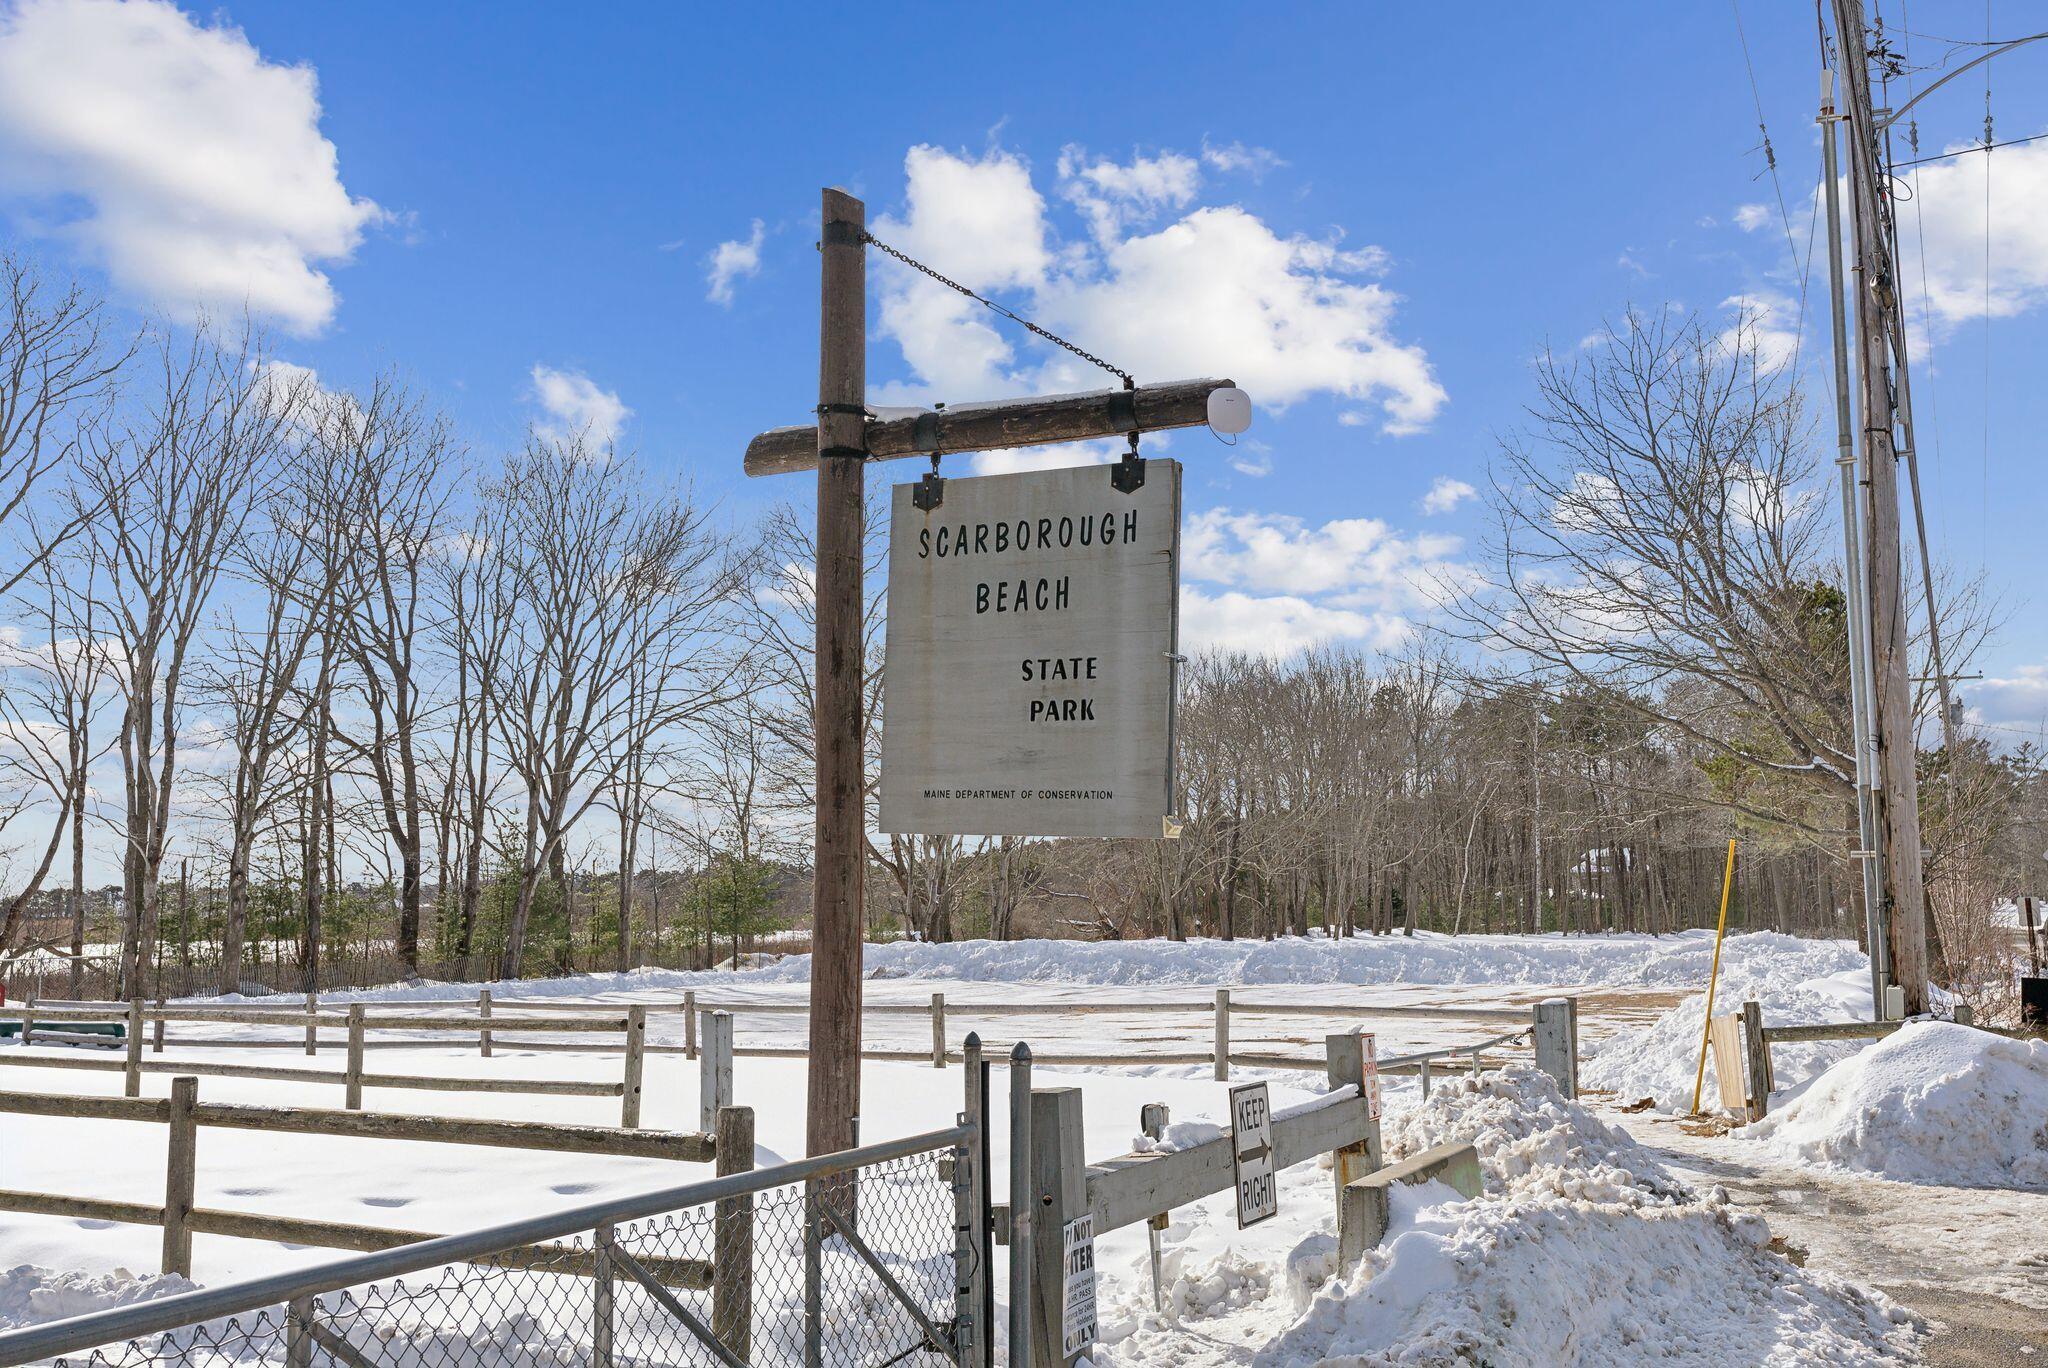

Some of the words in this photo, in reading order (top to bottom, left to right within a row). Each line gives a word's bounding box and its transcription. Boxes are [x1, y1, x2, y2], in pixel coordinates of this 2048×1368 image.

[918, 509, 1137, 558] SCARBOROUGH
[976, 576, 1069, 614] BEACH
[1021, 657, 1097, 681] STATE
[1030, 699, 1095, 722] PARK
[923, 789, 951, 799] MAINE
[955, 789, 1016, 799] DEPARTMENT
[1021, 790, 1033, 799] OF
[1038, 790, 1114, 800] CONSERVATION
[1238, 1097, 1265, 1132] KEEP
[1242, 1172, 1272, 1212] RIGHT
[1073, 1219, 1092, 1243] NOT
[1065, 1322, 1096, 1352] ONLY
